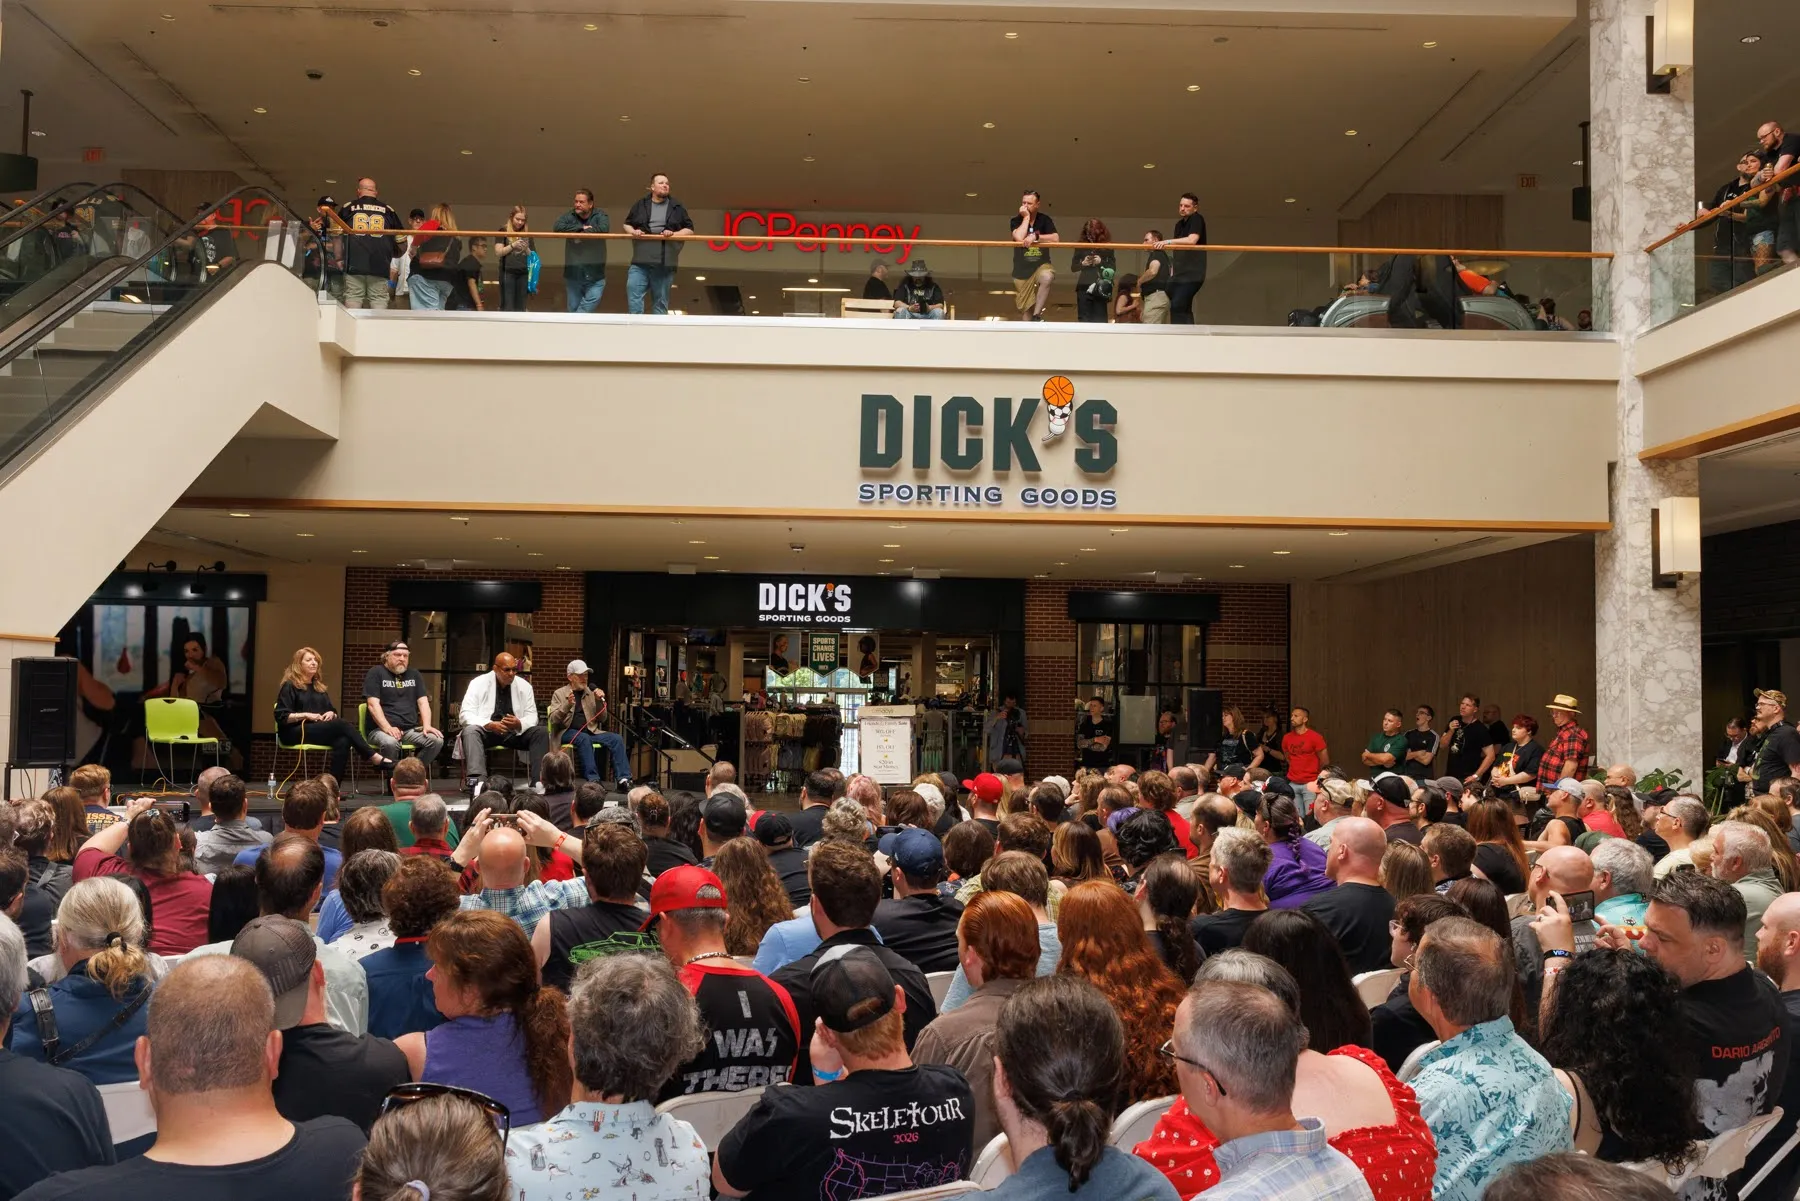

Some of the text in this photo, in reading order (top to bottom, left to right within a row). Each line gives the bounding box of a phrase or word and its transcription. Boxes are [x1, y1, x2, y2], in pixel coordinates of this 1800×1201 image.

[353, 213, 385, 238] 68
[707, 211, 921, 264] JCPenney
[860, 376, 1118, 474] DICK'S
[858, 483, 1117, 506] SPORTING GOODS
[759, 583, 851, 612] DICK'S
[815, 615, 851, 623] GOODS
[812, 637, 835, 645] SPORTS
[812, 653, 835, 662] LIVES
[382, 680, 395, 688] CULT
[86, 812, 121, 822] ISSEY
[737, 990, 753, 1019] I
[713, 1027, 778, 1059] WAS
[1711, 1045, 1750, 1060] DARIO
[892, 1132, 919, 1144] 2026
